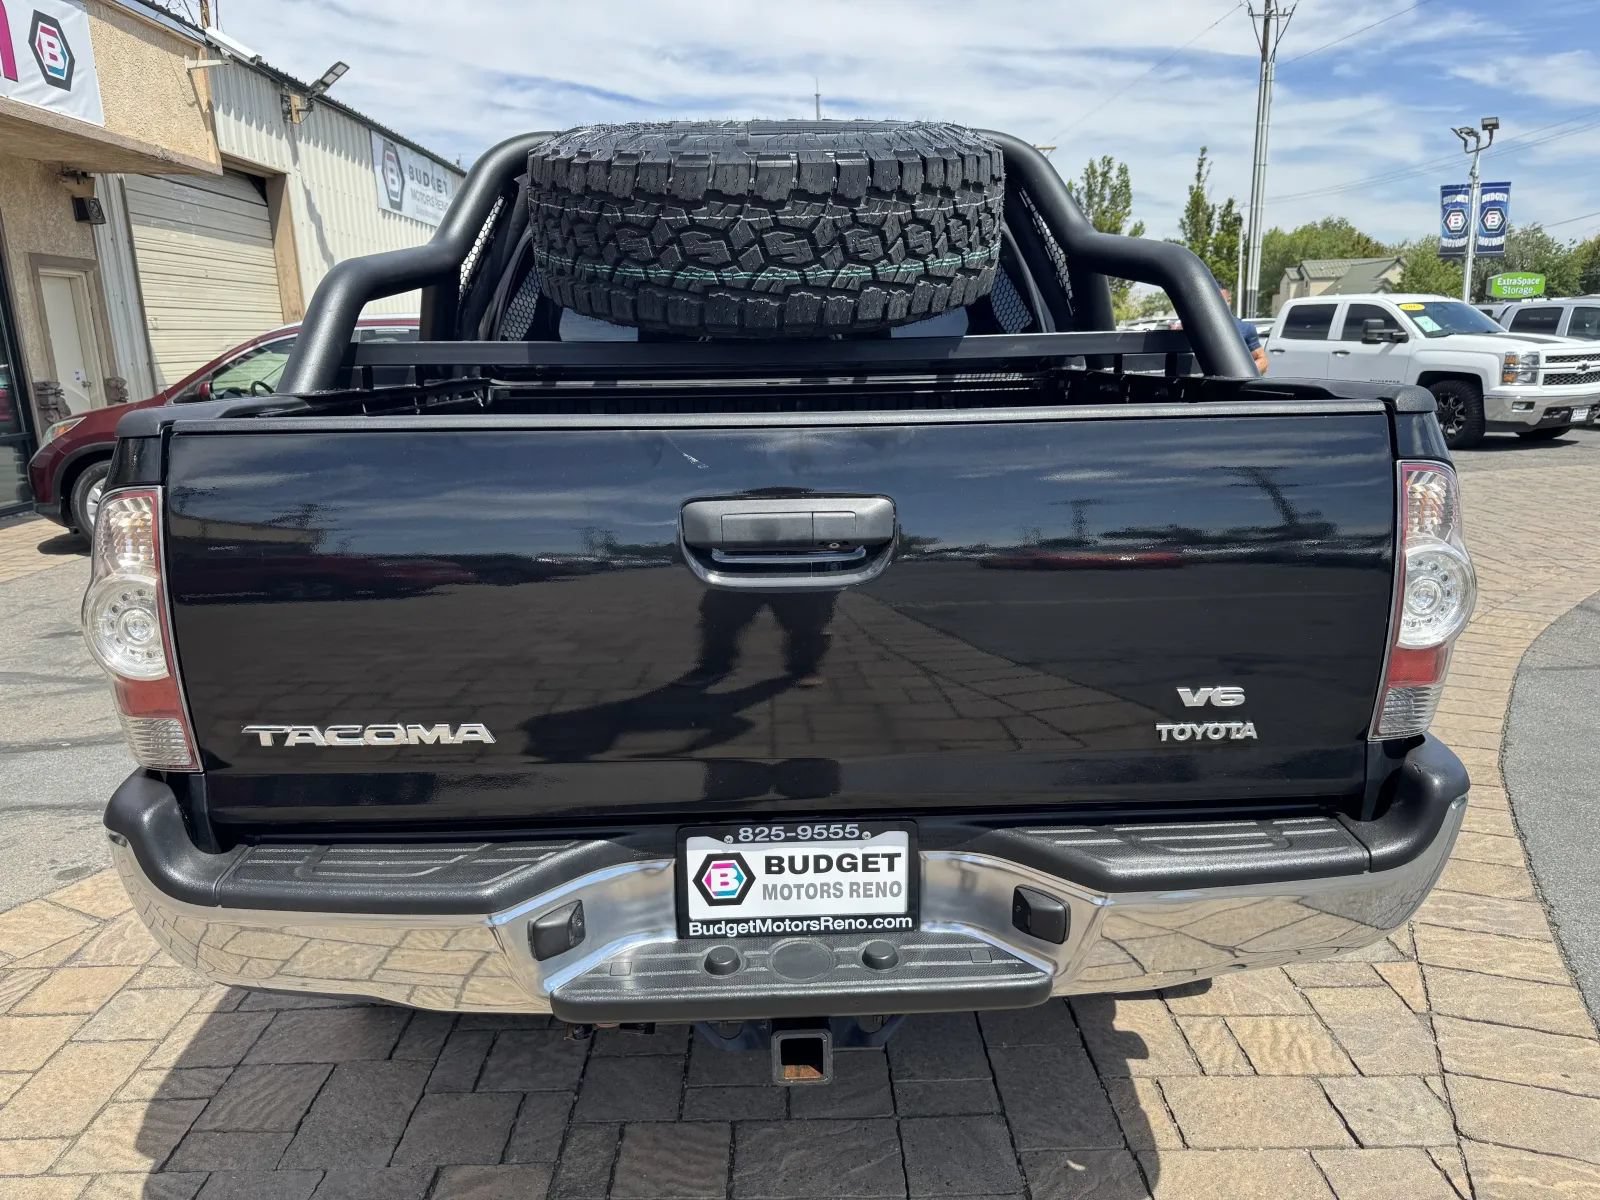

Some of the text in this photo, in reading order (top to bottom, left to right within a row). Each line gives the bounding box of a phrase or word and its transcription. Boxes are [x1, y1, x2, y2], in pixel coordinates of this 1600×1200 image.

[1497, 277, 1540, 287] ExtraSpace
[1176, 686, 1246, 707] V6
[242, 723, 497, 747] TACOMA
[1155, 722, 1258, 741] TOYOTA
[738, 823, 860, 843] 825-9555
[764, 852, 902, 875] BUDGET
[762, 880, 903, 901] MOTORS RENO
[688, 915, 914, 938] BudgetMotorsReno.com
